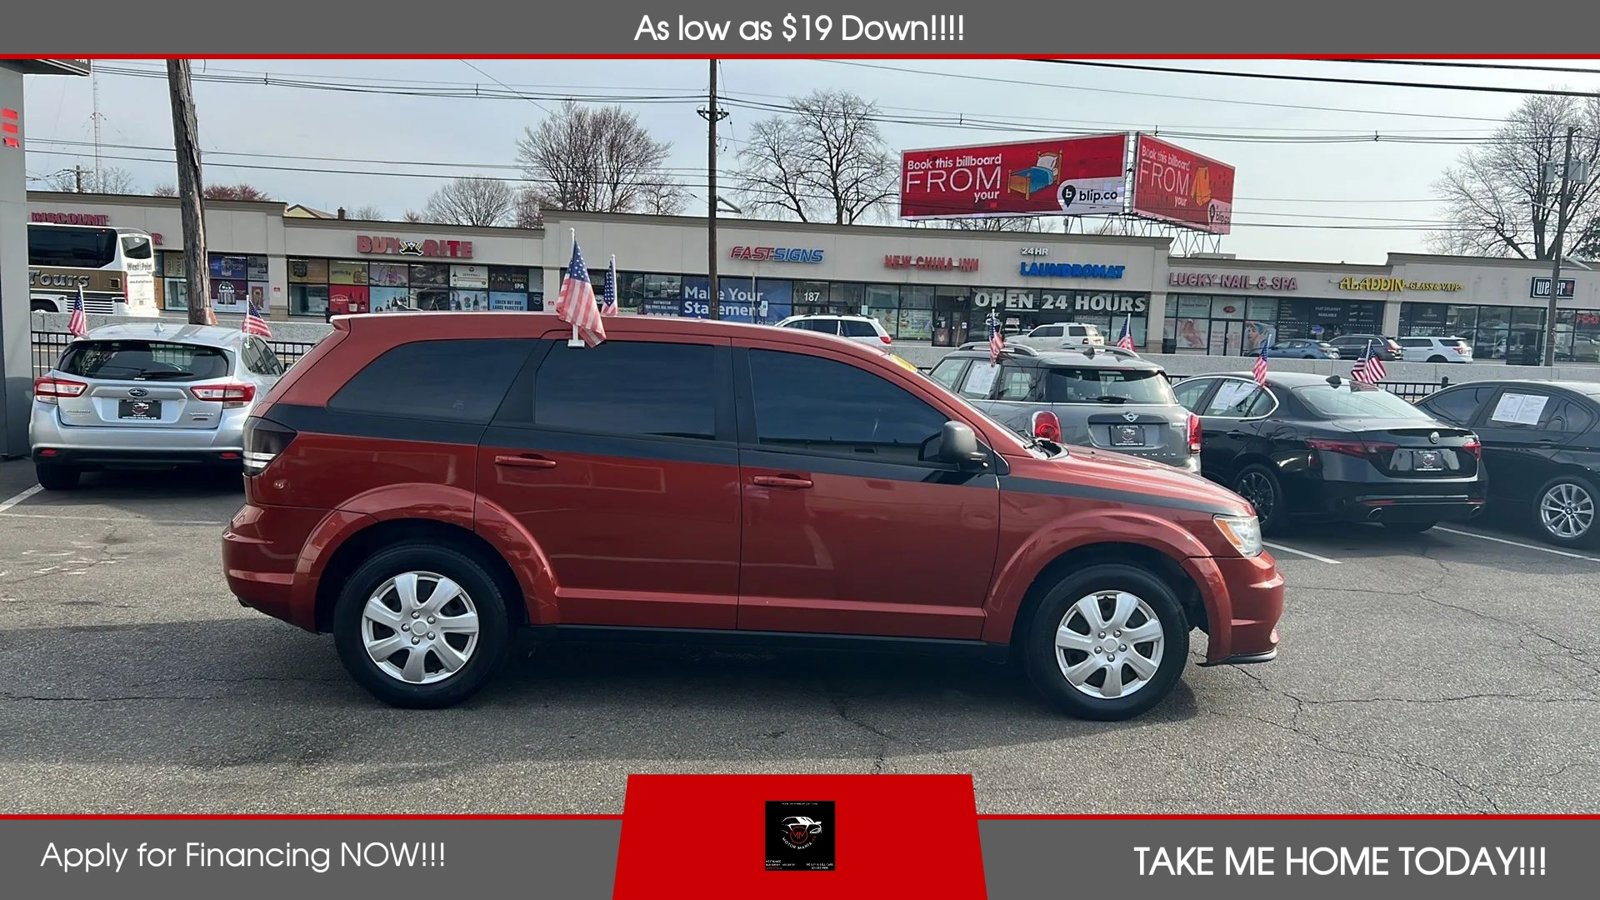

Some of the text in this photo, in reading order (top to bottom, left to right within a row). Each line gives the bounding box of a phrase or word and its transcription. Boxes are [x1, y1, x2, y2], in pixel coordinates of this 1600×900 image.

[907, 153, 1002, 170] Book this billboard
[1142, 145, 1157, 160] Book
[1168, 153, 1191, 171] billboard
[906, 166, 1001, 193] FROM
[1140, 159, 1190, 196] FROM
[974, 190, 1000, 203] your
[1079, 189, 1118, 203] blip.co
[357, 235, 474, 259] BUY RITE
[730, 246, 825, 264] FASTSIGNS
[884, 254, 979, 272] NEW CHINA INN
[1020, 262, 1126, 279] LAUNDROMAT
[29, 269, 89, 288] Tours
[1169, 272, 1298, 290] LUCKY NAIL & SPA
[1339, 277, 1405, 292] ALADDIN
[684, 286, 764, 302] Mae Your
[804, 291, 820, 302] 187
[1536, 281, 1566, 296] wer
[684, 301, 764, 317] Staemen
[975, 292, 1146, 312] OPEN 24 HOURS
